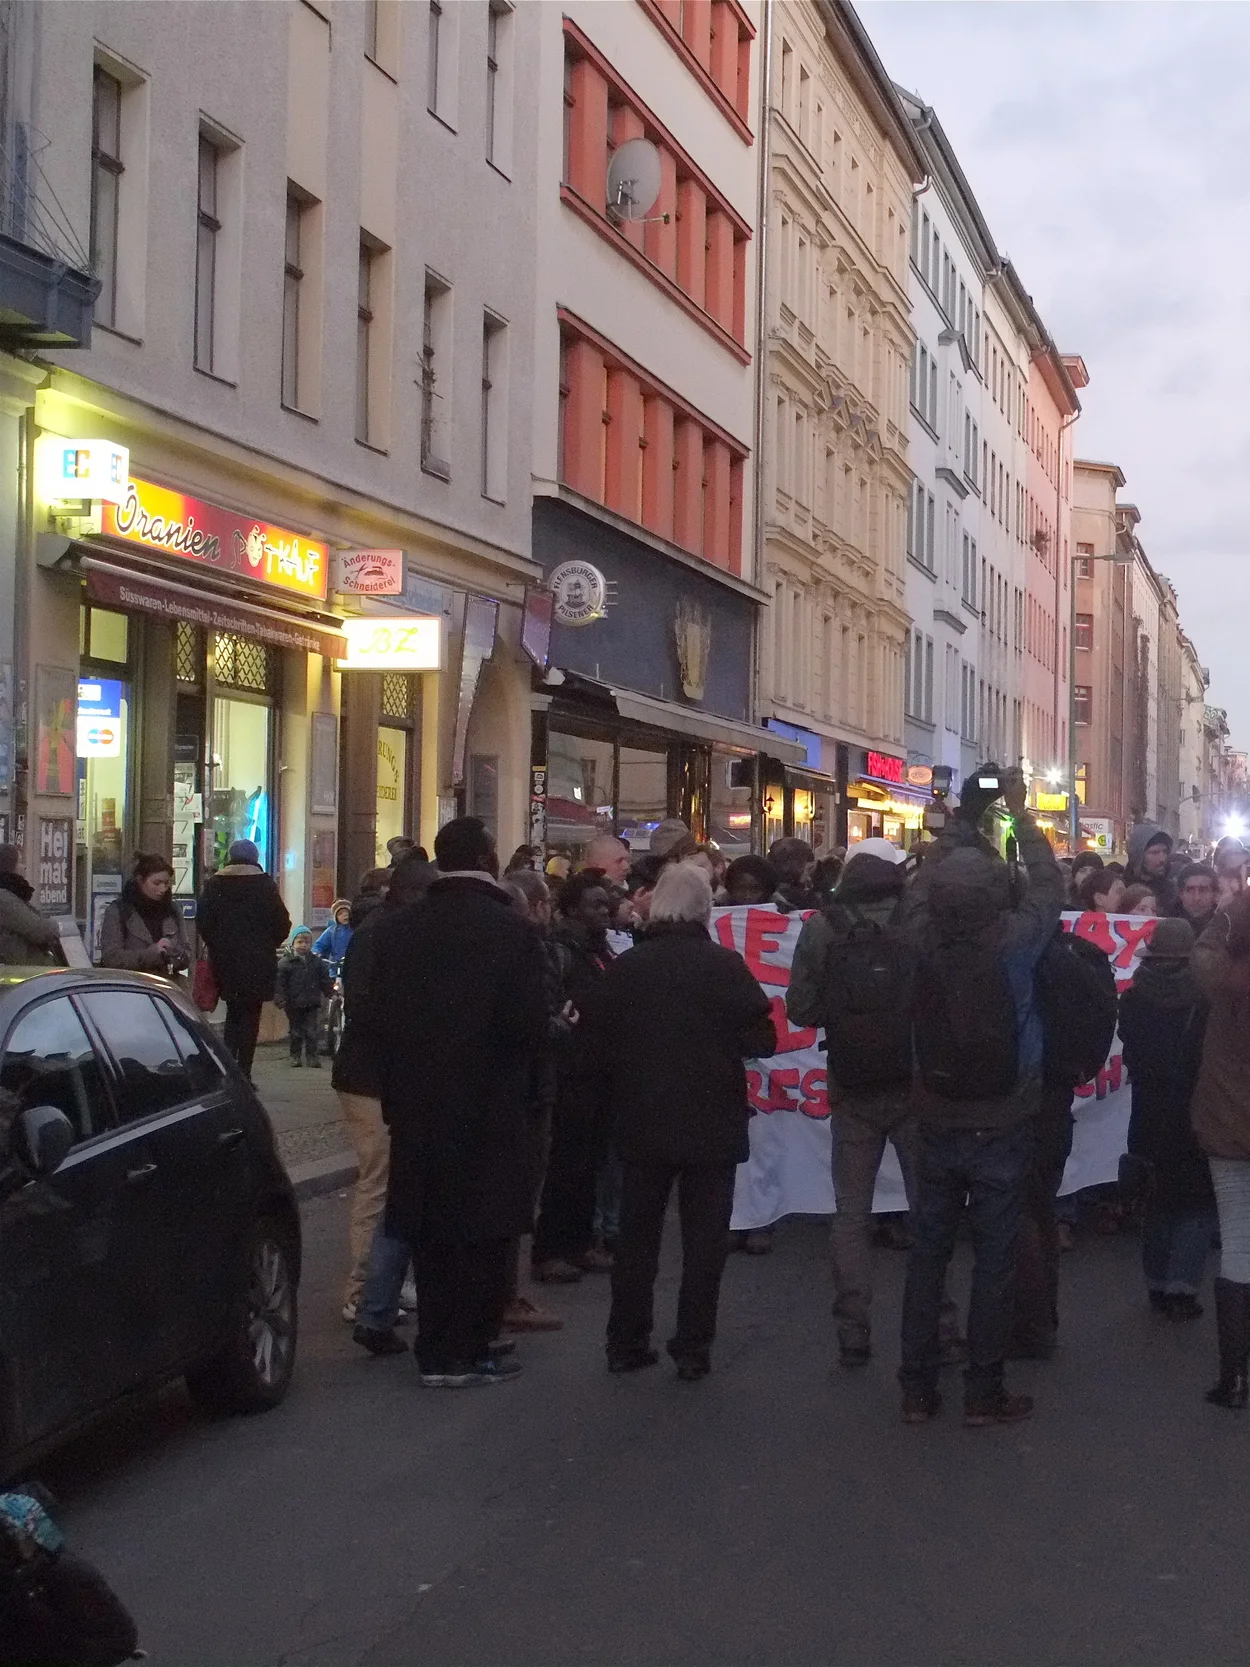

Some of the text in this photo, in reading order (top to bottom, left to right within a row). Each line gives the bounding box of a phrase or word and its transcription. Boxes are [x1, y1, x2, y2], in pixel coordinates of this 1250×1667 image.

[63, 449, 90, 478] EC
[116, 483, 221, 562] Oranien
[341, 553, 396, 569] Änderungs-
[343, 576, 396, 592] Schneiderei
[553, 566, 598, 589] FLENSBURGER
[558, 604, 594, 619] PILSENER
[40, 823, 68, 859] Hei
[39, 861, 68, 885] mat
[39, 885, 68, 904] abend
